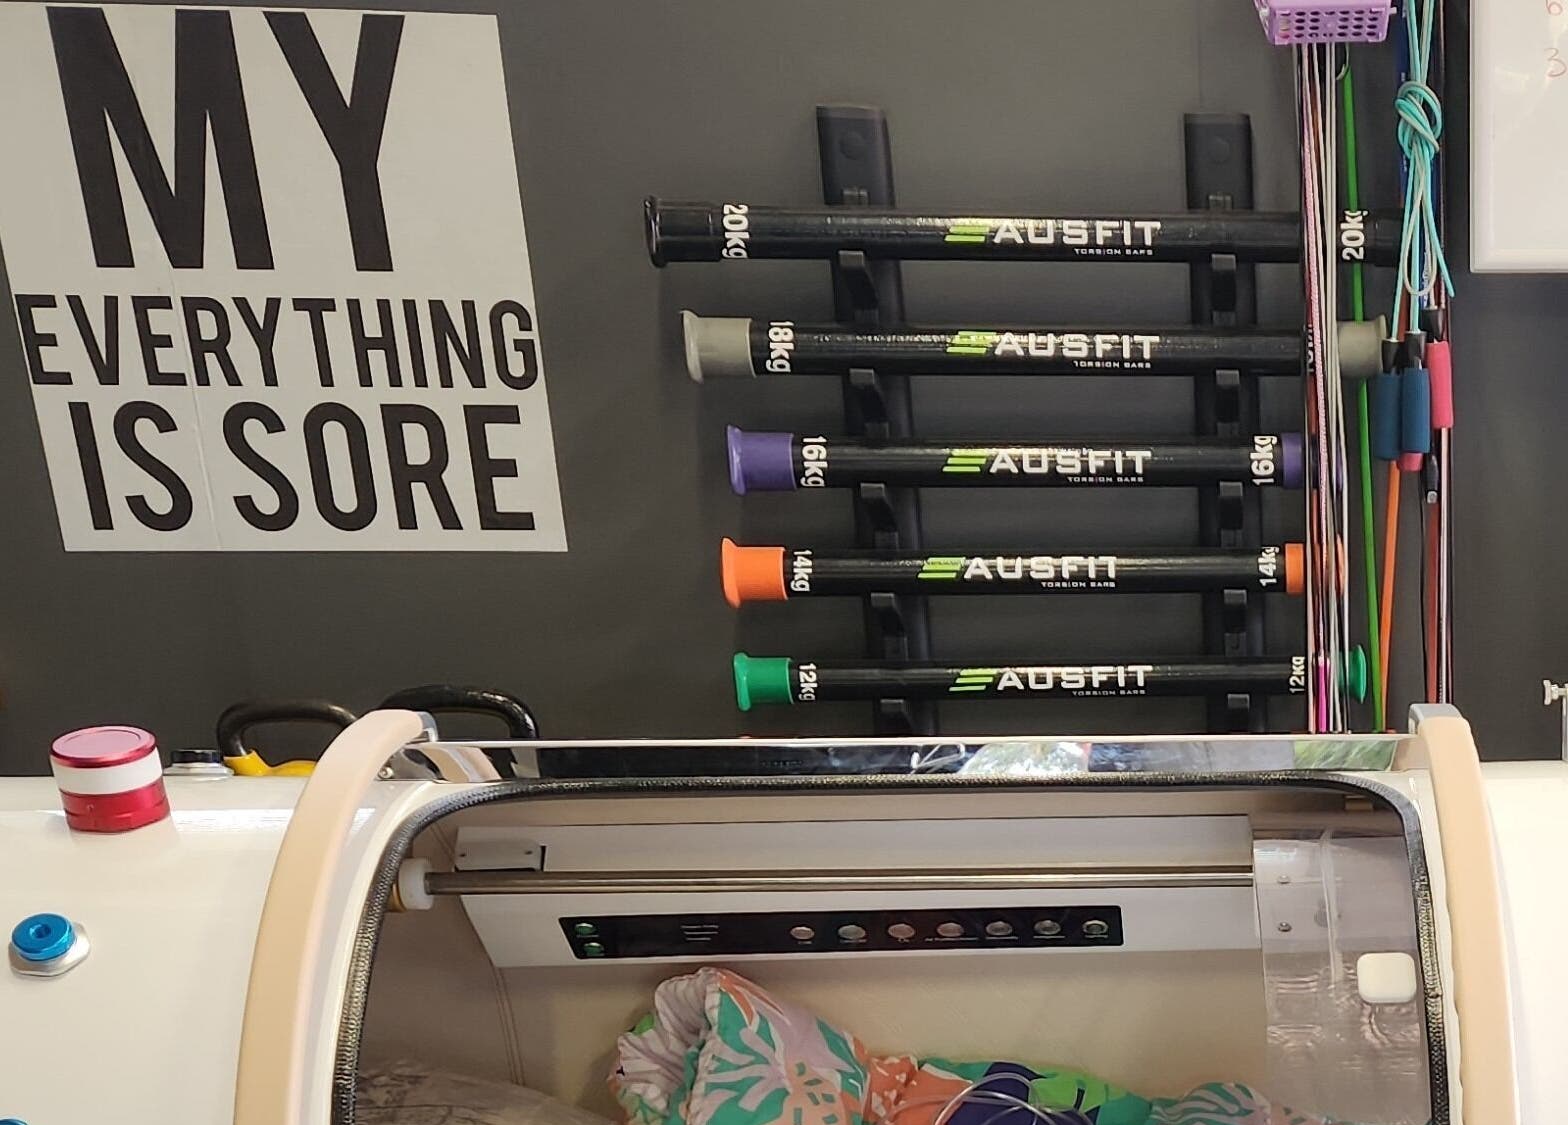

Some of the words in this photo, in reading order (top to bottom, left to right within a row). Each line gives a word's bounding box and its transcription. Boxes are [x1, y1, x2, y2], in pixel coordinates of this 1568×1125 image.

[46, 6, 405, 271] MY
[721, 203, 749, 260] 20kg
[993, 219, 1161, 246] AUSFIT
[14, 293, 539, 391] EVERYTHING
[765, 320, 794, 374] 18kg
[994, 332, 1160, 359] AUSFIT
[67, 401, 194, 532] IS
[222, 401, 537, 532] SORE
[800, 435, 828, 488] 16kg
[989, 450, 1152, 475] AUSFIT
[1250, 435, 1278, 487] 16kg
[790, 549, 813, 592] 14kg
[963, 556, 1117, 580] AUSFIT
[798, 662, 819, 701] 12kg
[997, 665, 1153, 690] AUSFIT
